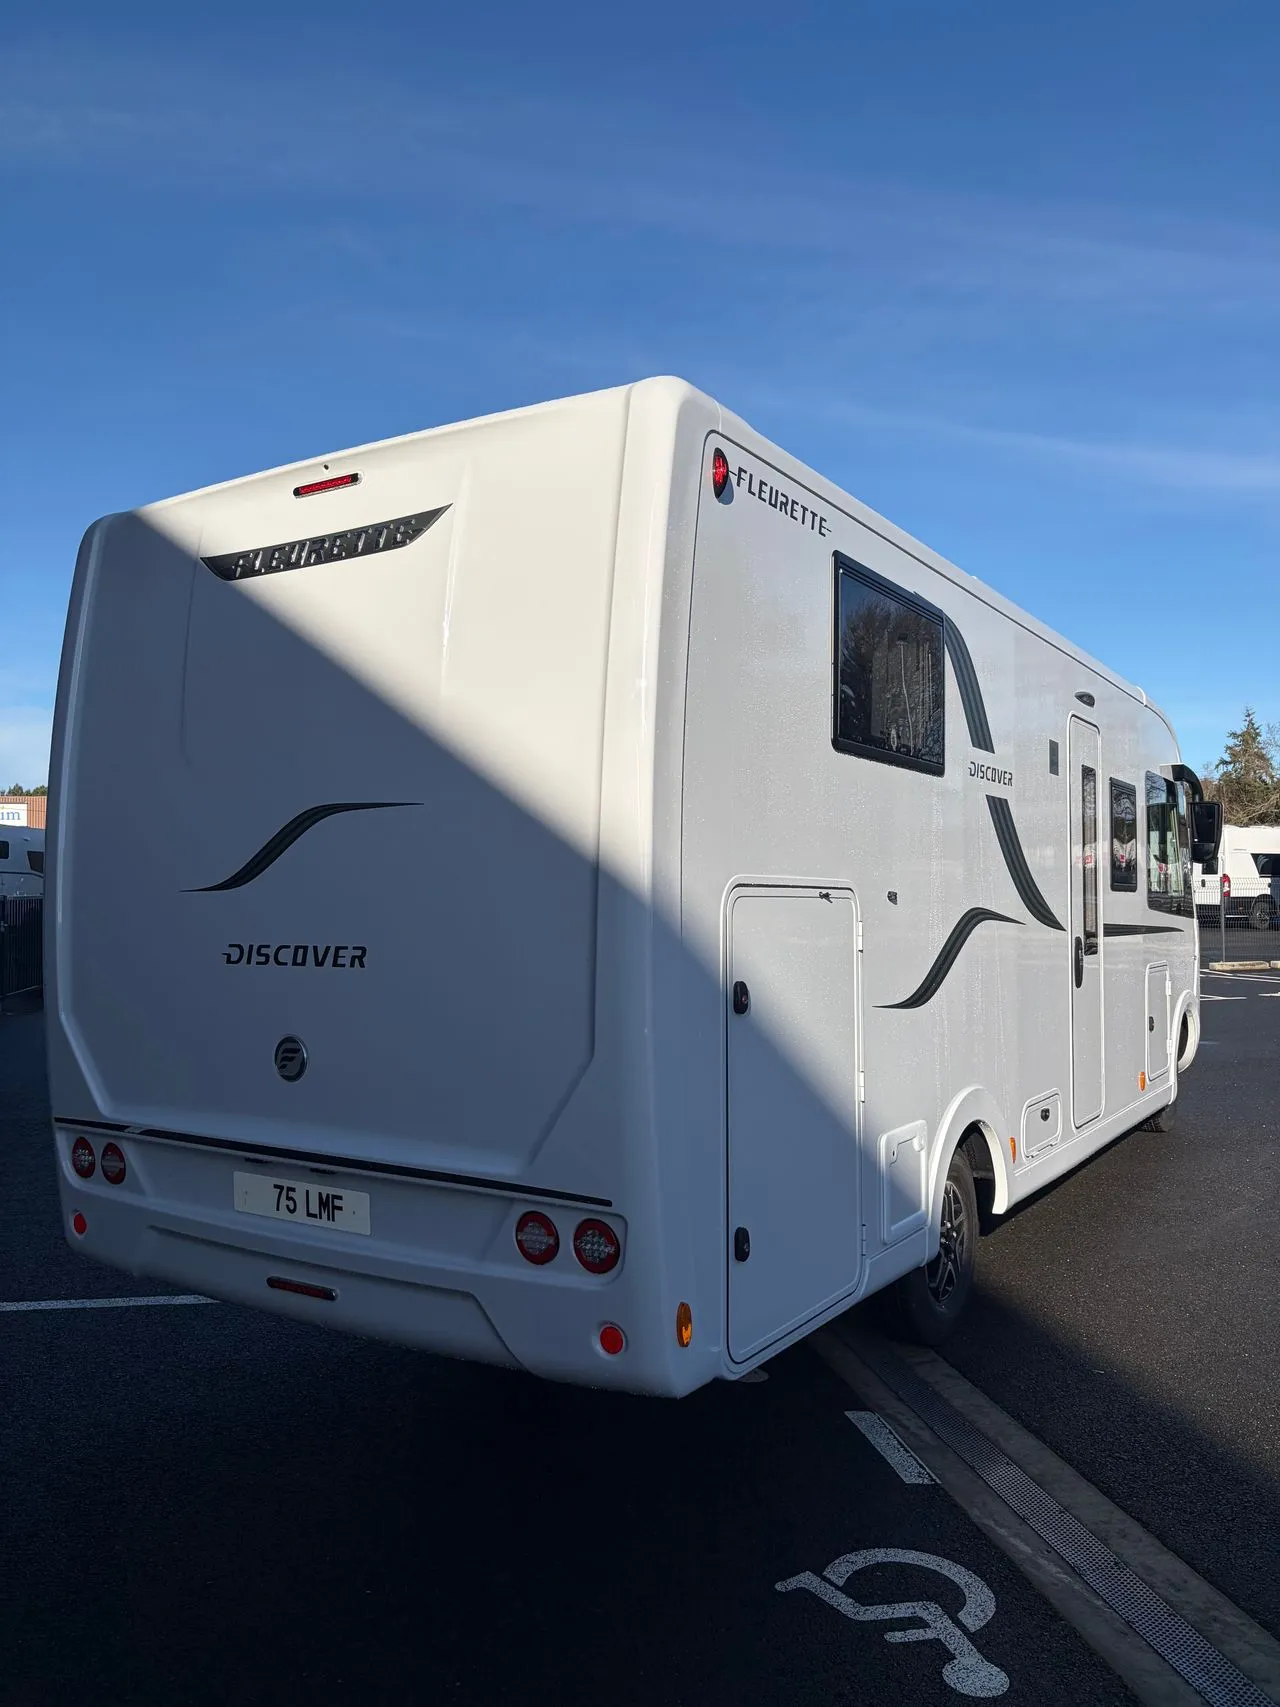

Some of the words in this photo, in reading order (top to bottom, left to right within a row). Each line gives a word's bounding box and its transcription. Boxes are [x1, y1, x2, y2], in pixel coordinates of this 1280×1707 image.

[736, 466, 832, 537] FLEURETTE
[233, 519, 420, 578] FLEURETTE
[968, 761, 1013, 787] DISCOVER
[221, 943, 368, 968] DISCOVER
[273, 1184, 297, 1214] 75
[305, 1190, 343, 1222] LMF
